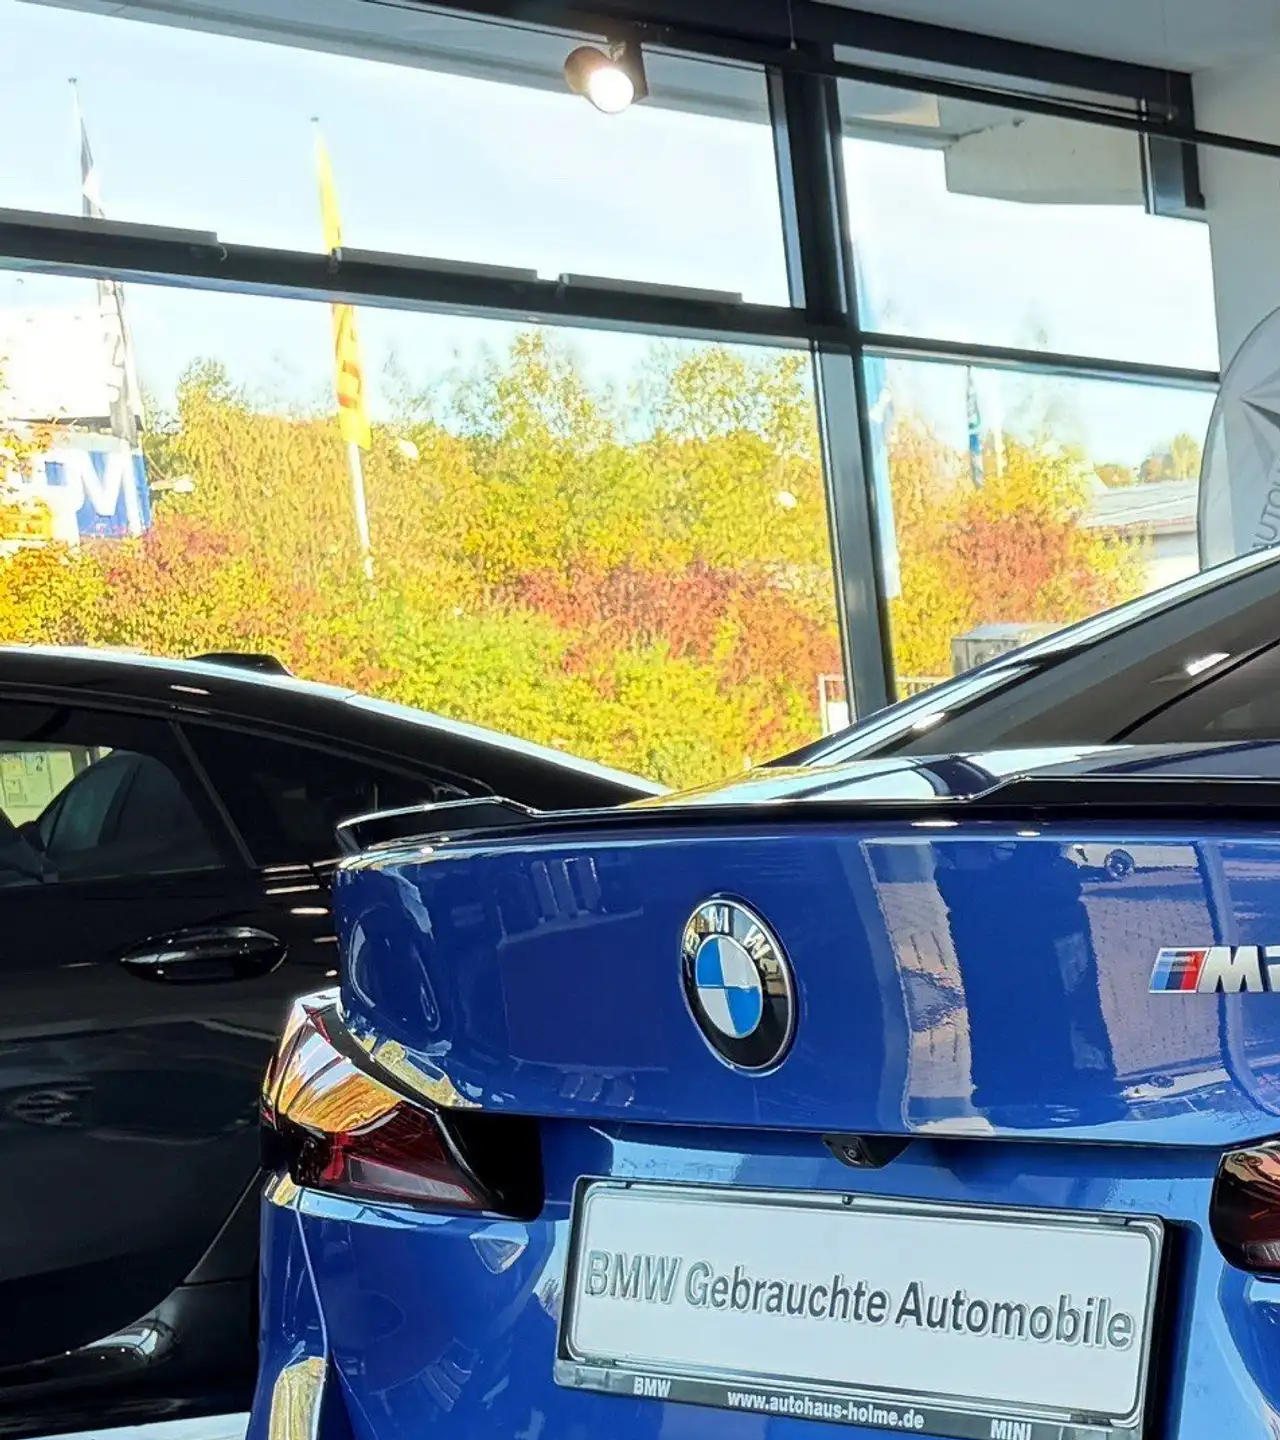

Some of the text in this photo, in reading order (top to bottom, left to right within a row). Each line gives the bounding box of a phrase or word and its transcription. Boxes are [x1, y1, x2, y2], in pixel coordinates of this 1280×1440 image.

[685, 906, 772, 960] BMW
[585, 1249, 1136, 1349] BMW Gebrauchte Automobile
[632, 1376, 672, 1398] BMW
[727, 1391, 926, 1430] www.autohaus-holme.de
